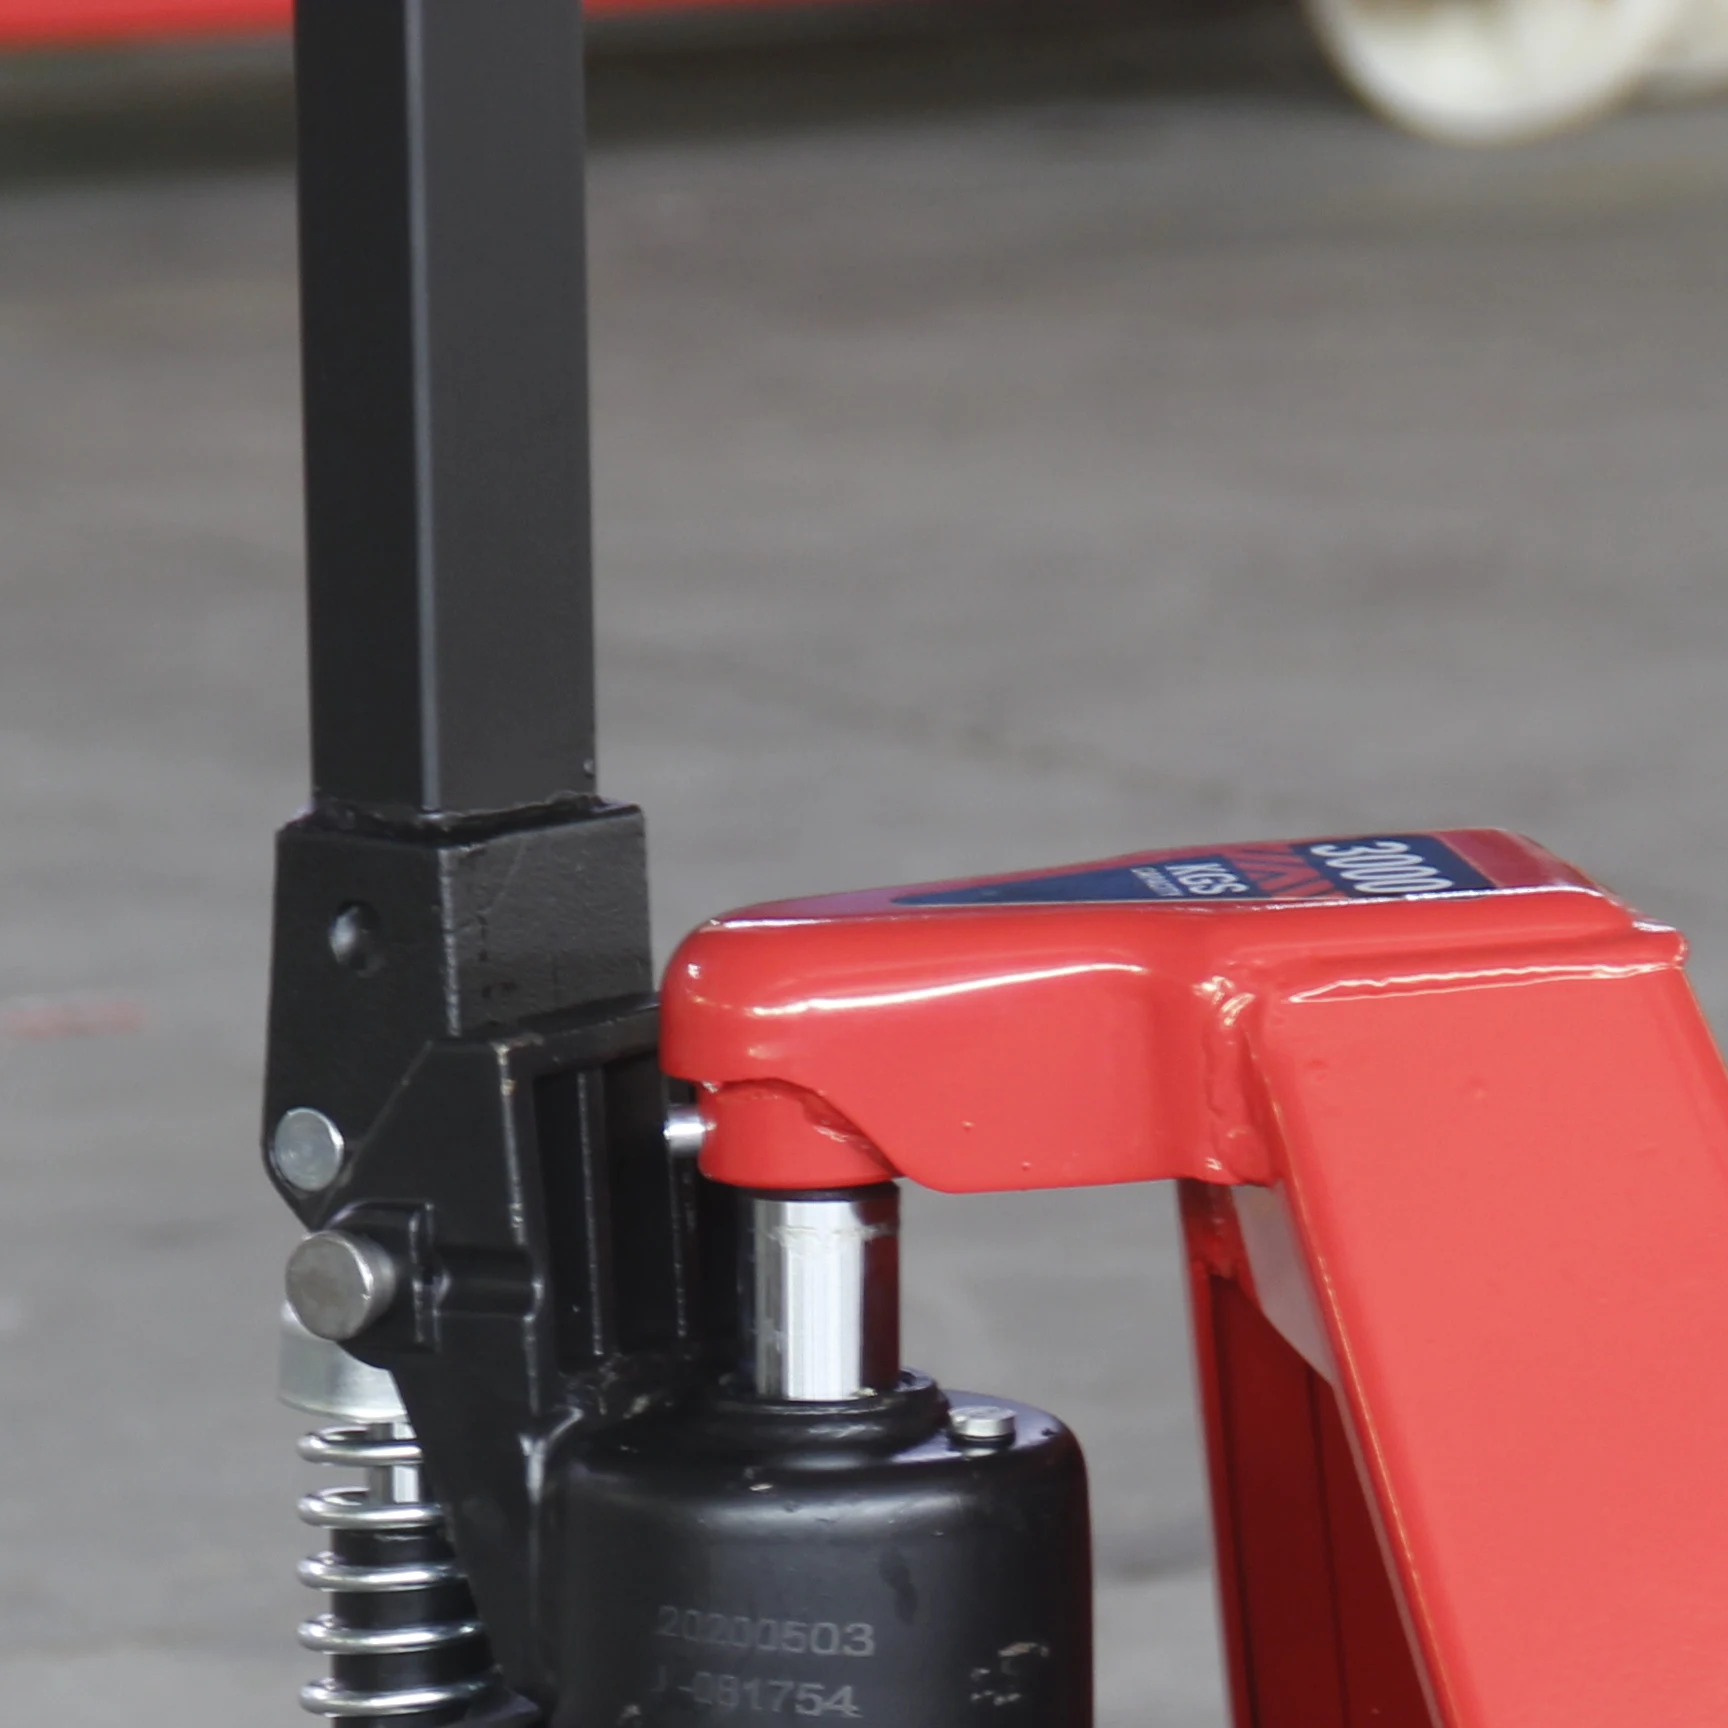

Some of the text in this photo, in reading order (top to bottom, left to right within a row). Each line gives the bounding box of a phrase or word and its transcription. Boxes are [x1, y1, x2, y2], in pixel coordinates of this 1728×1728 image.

[1164, 862, 1250, 895] KGS
[1310, 840, 1455, 893] 3000
[654, 1605, 875, 1657] 20200503
